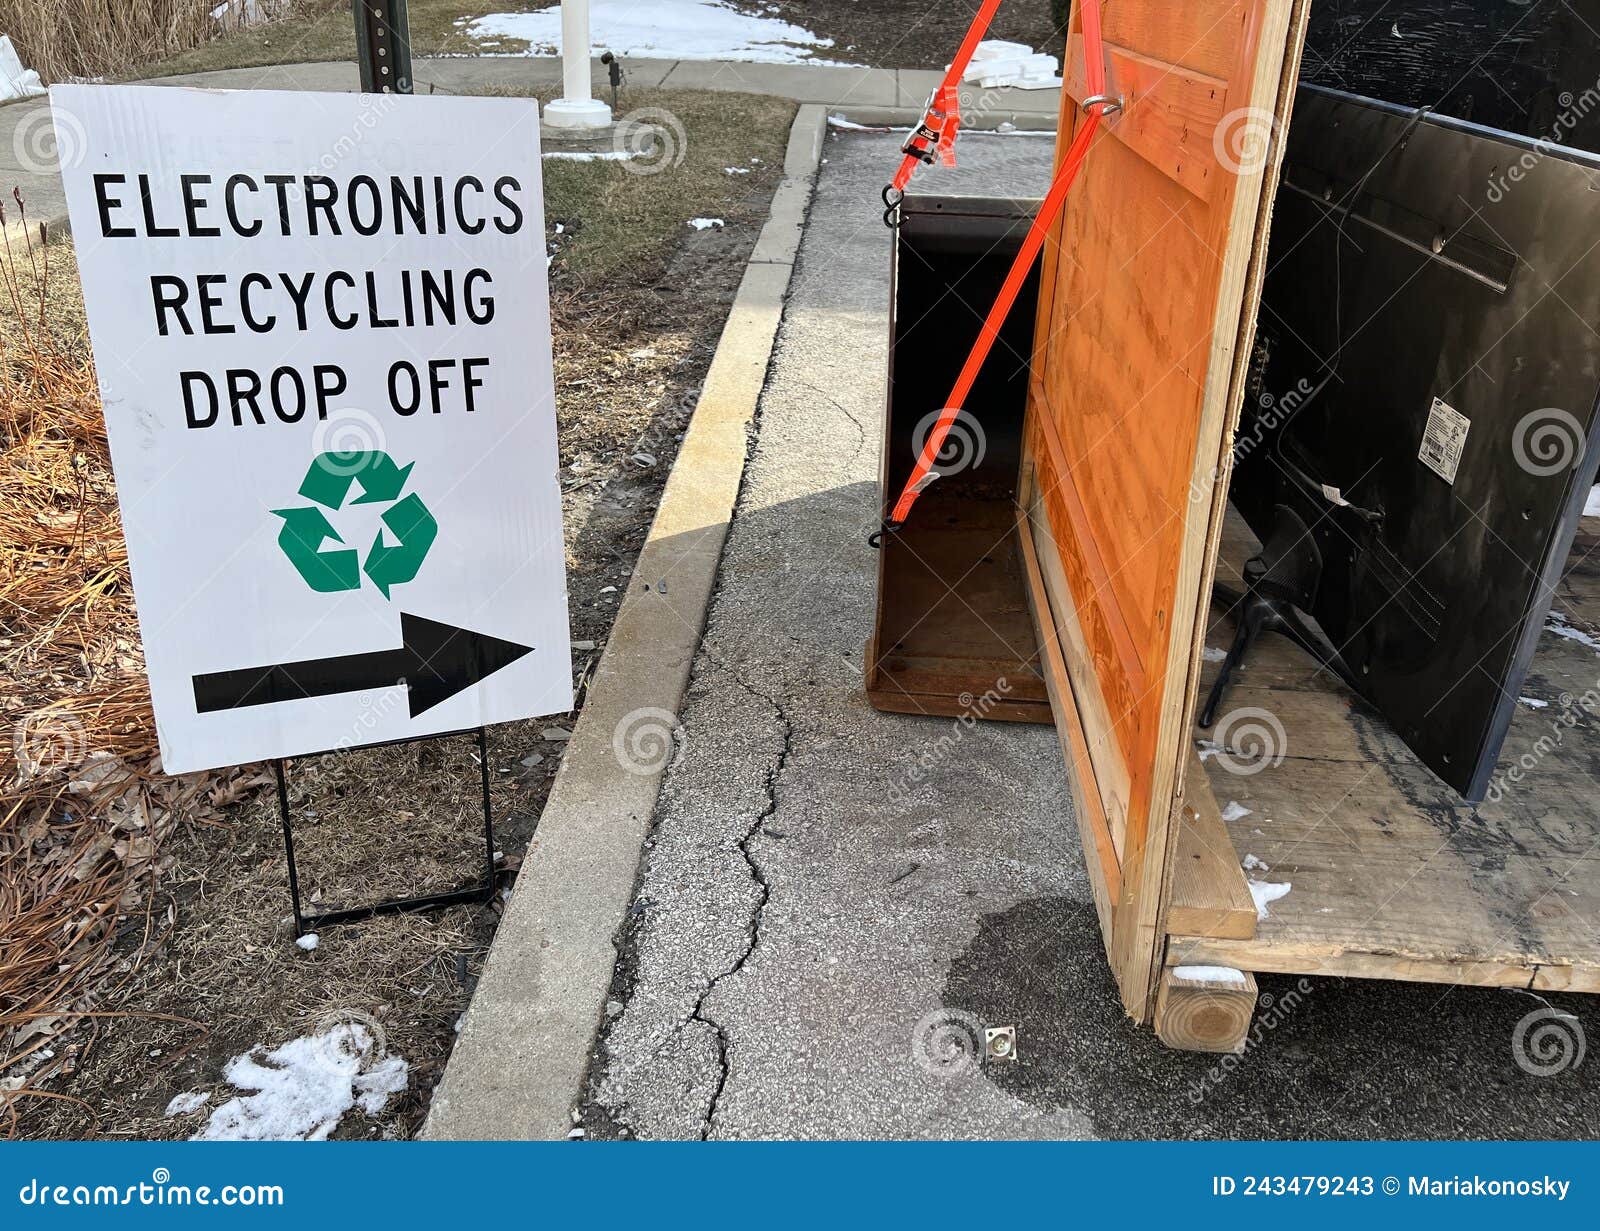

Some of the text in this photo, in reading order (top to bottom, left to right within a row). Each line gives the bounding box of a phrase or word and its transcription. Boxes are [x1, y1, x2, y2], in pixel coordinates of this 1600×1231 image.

[92, 173, 523, 238] ELECTRONICS
[150, 267, 495, 336] RECYCLING
[179, 357, 490, 429] DROP OFF
